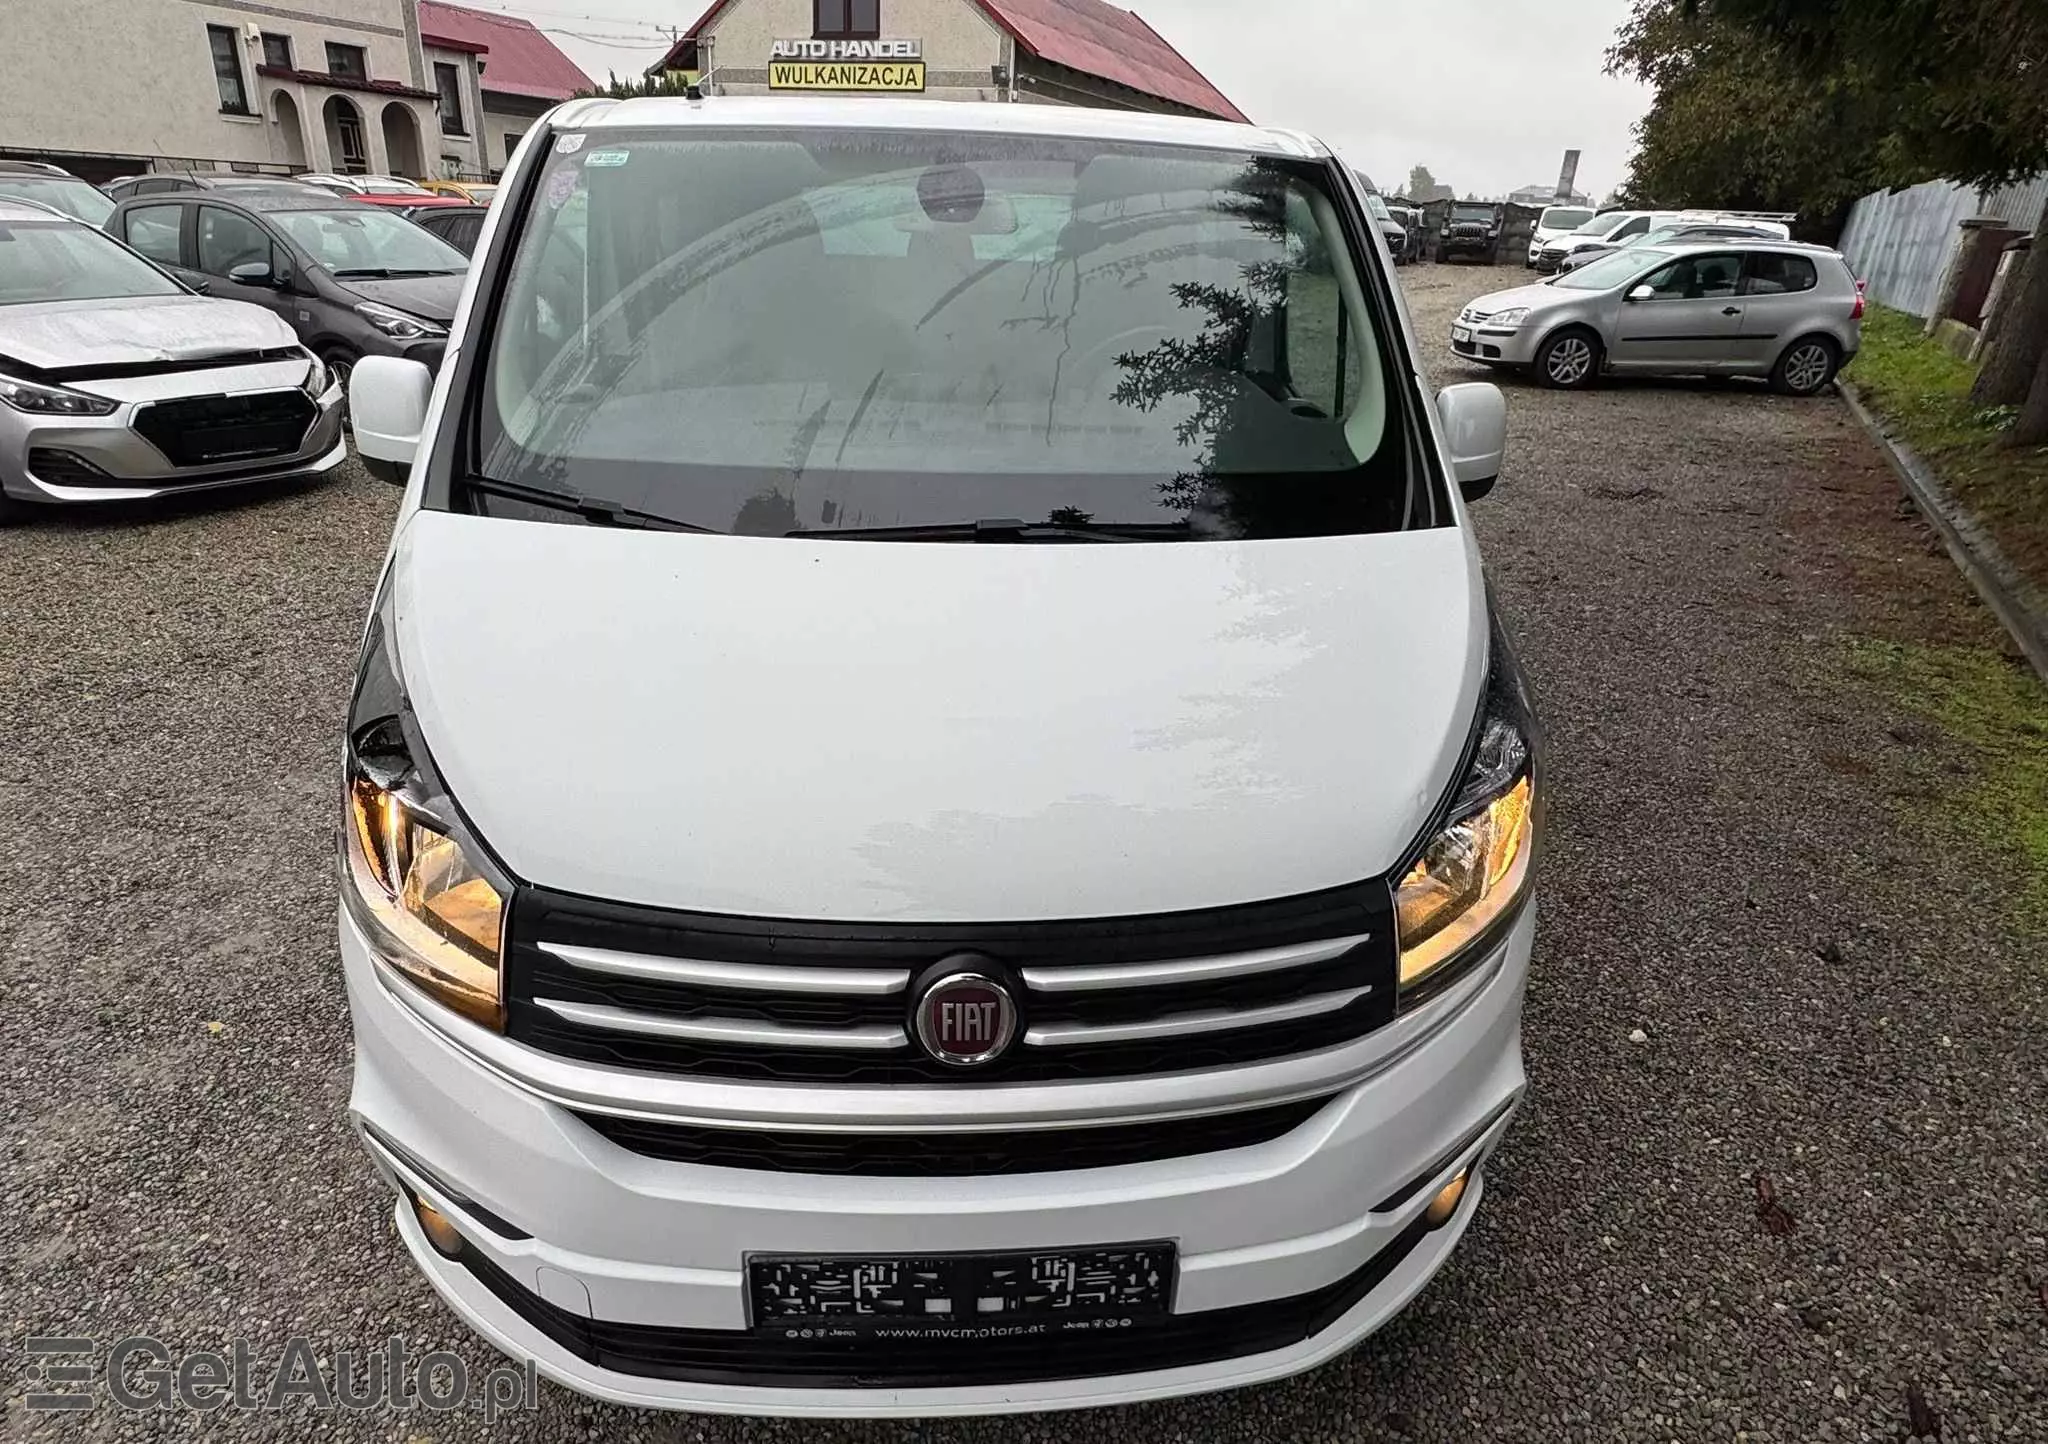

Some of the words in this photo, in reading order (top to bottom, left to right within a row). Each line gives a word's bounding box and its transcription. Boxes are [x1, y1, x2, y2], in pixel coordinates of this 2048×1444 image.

[770, 39, 827, 58] AUTO
[831, 40, 921, 58] HANDEL
[775, 65, 919, 87] WULKANIZACJA
[941, 1002, 998, 1041] FIAT
[875, 1324, 1046, 1338] www.mvcmotors.at
